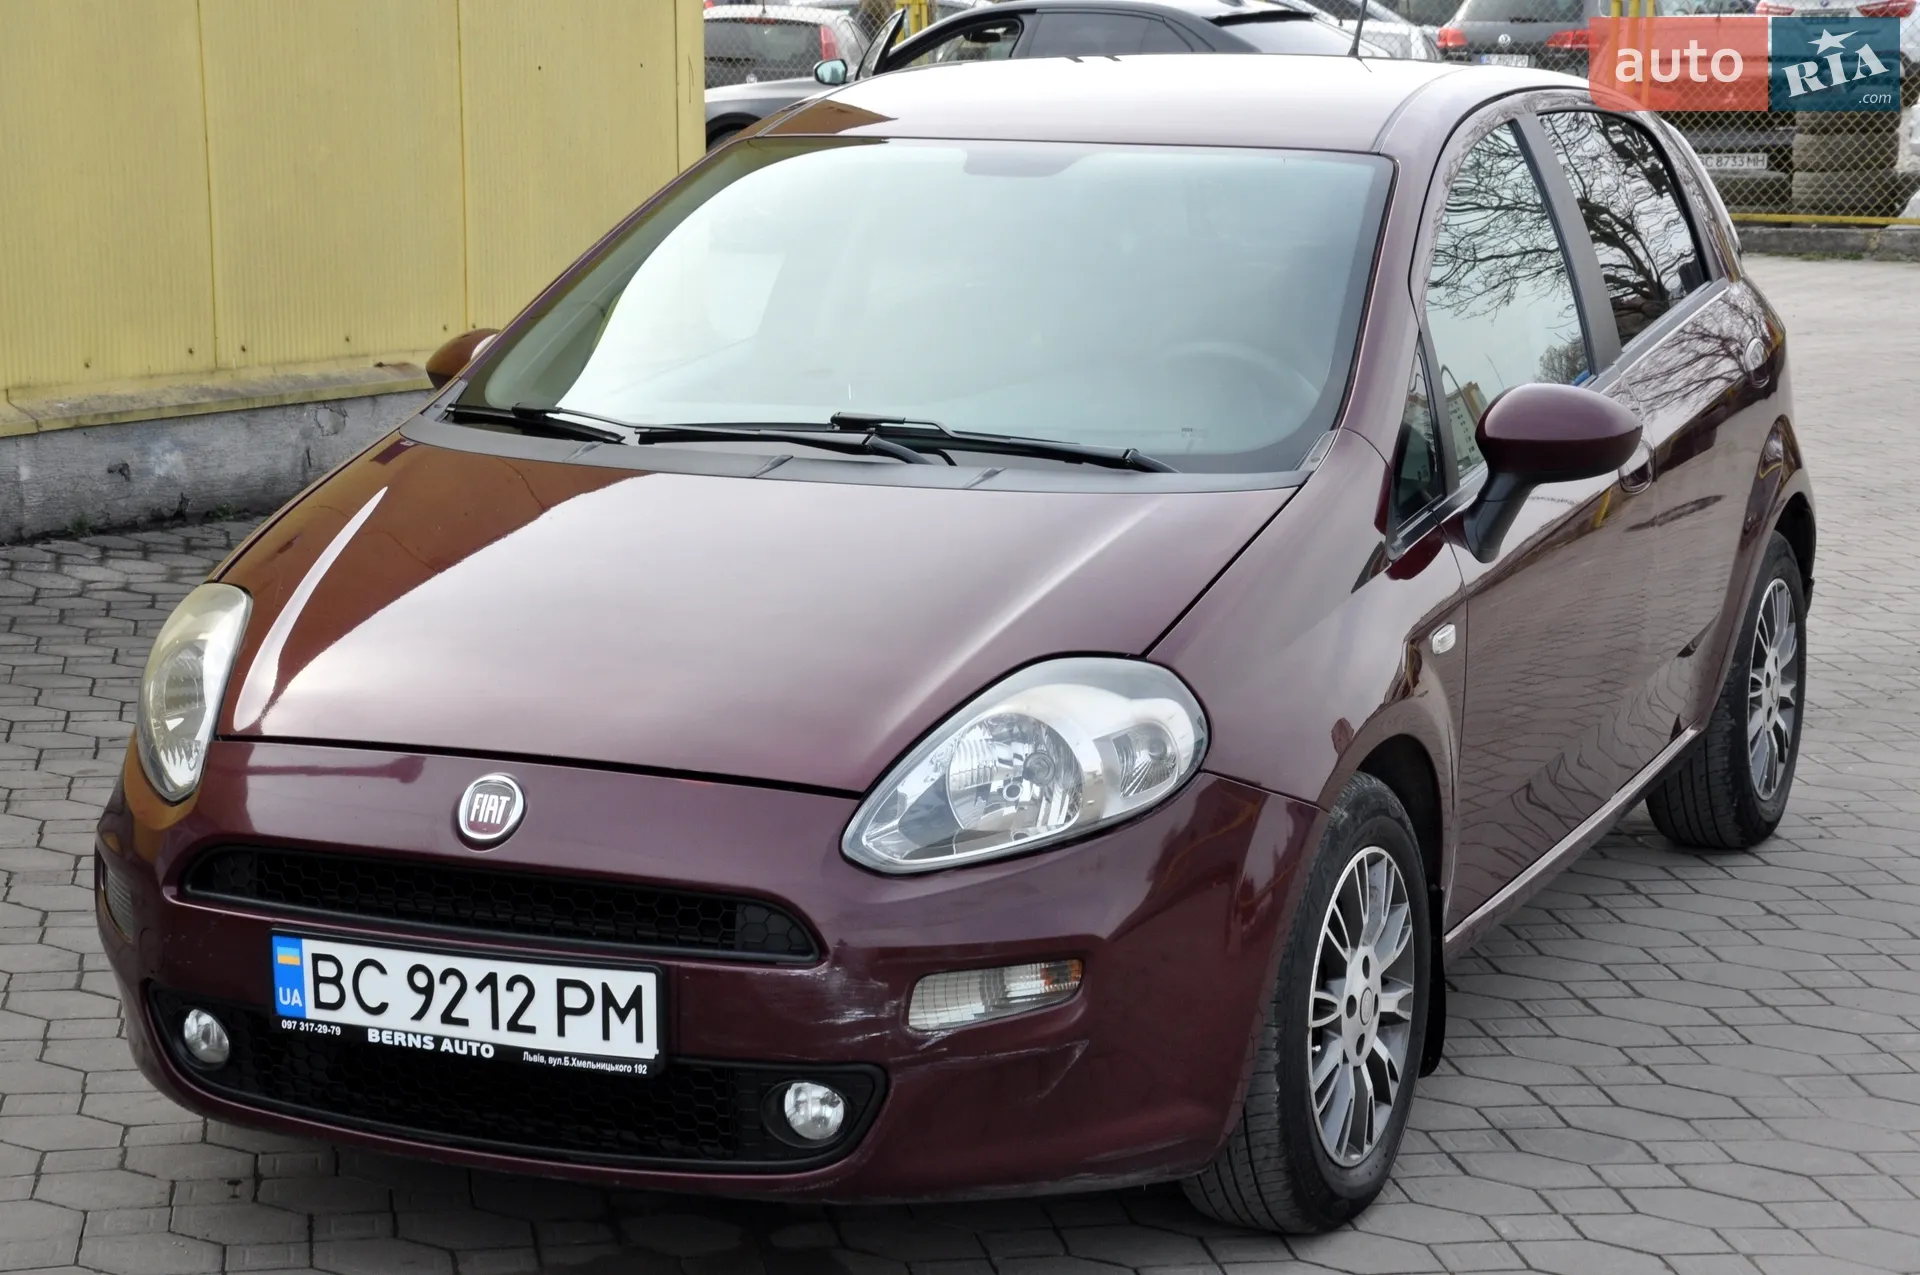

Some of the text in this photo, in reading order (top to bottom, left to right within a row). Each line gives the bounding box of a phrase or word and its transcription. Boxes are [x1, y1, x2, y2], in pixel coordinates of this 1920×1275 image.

[1716, 156, 1745, 168] 8733
[1747, 156, 1765, 167] MH
[469, 793, 511, 825] FIAT
[279, 986, 303, 1007] UA
[311, 952, 644, 1043] BC 9212 PM
[281, 1019, 341, 1036] 097 317-29-79
[367, 1028, 495, 1058] BERNS AUTO
[523, 1051, 648, 1075] Львів, вул.Б.Хмельницького 192
